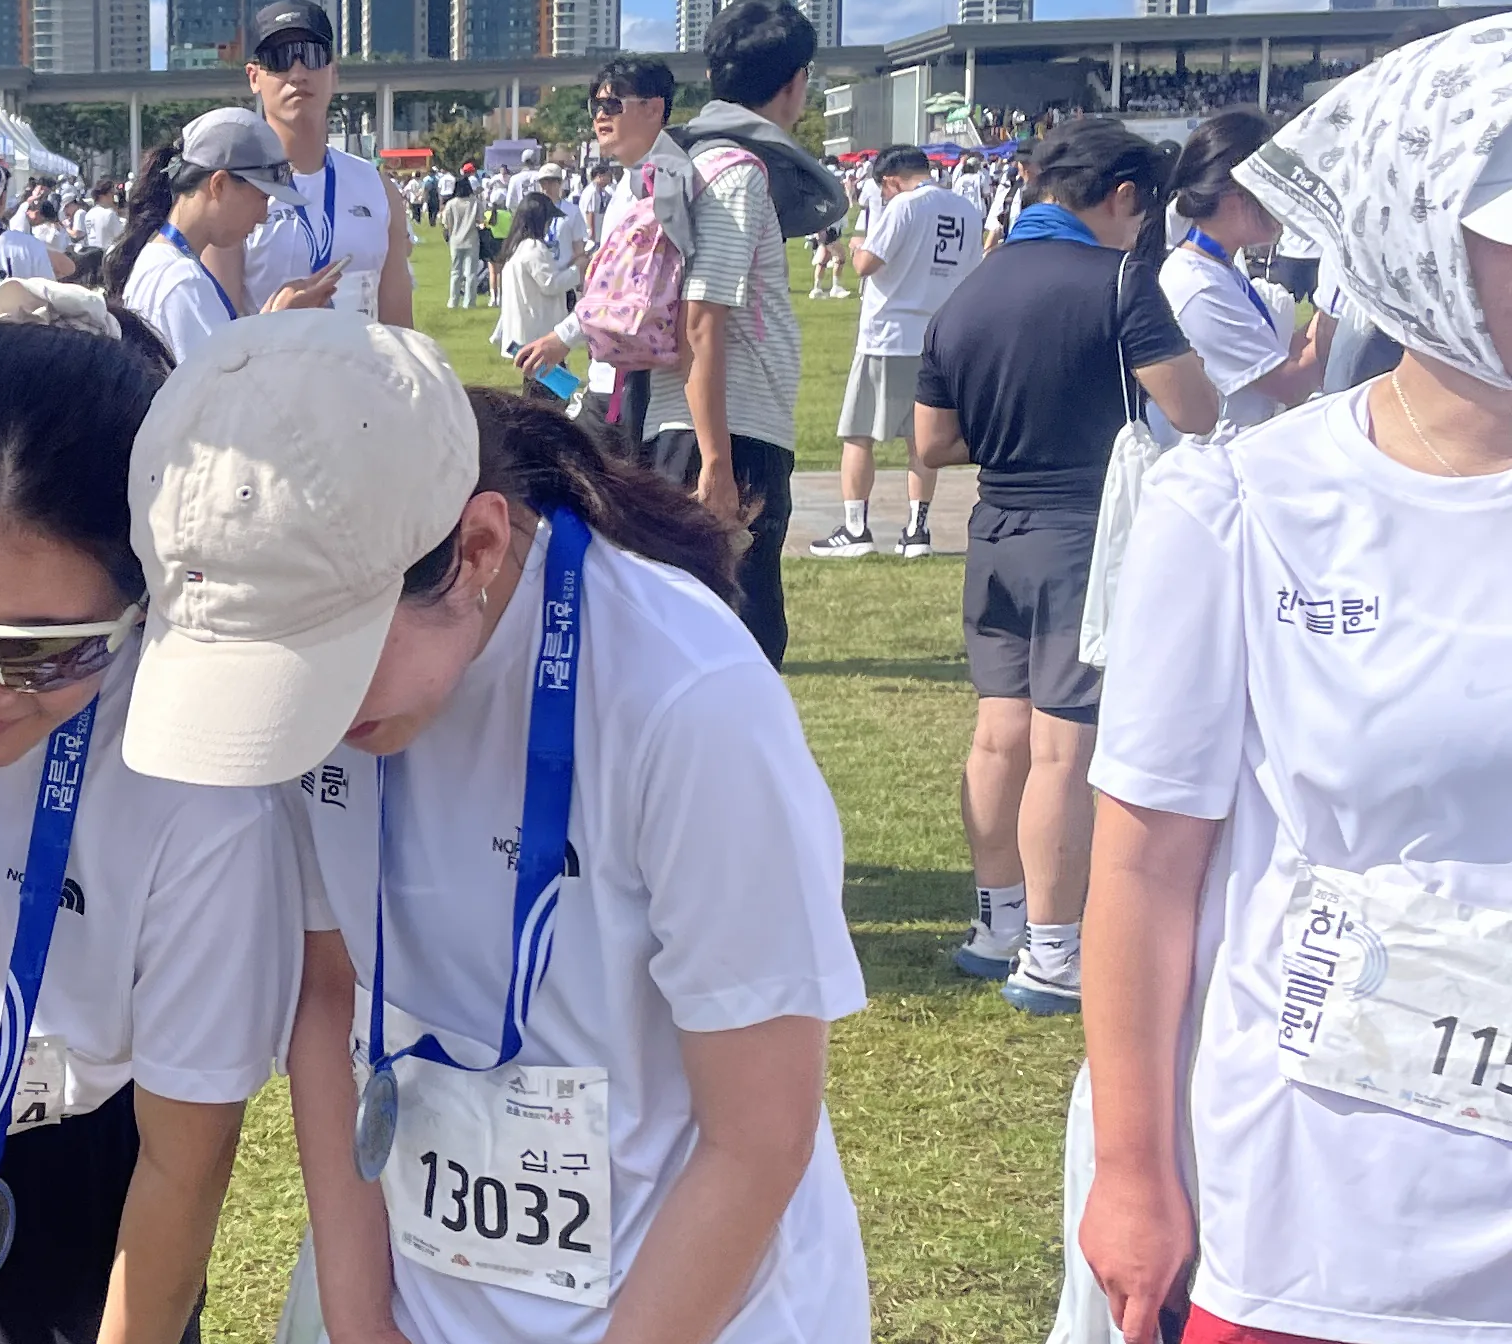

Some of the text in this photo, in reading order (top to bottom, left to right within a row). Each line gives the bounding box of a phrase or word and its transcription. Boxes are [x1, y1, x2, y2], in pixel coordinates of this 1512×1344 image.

[563, 570, 576, 601] 2025
[1314, 888, 1340, 904] 2025
[420, 1151, 592, 1254] 13032
